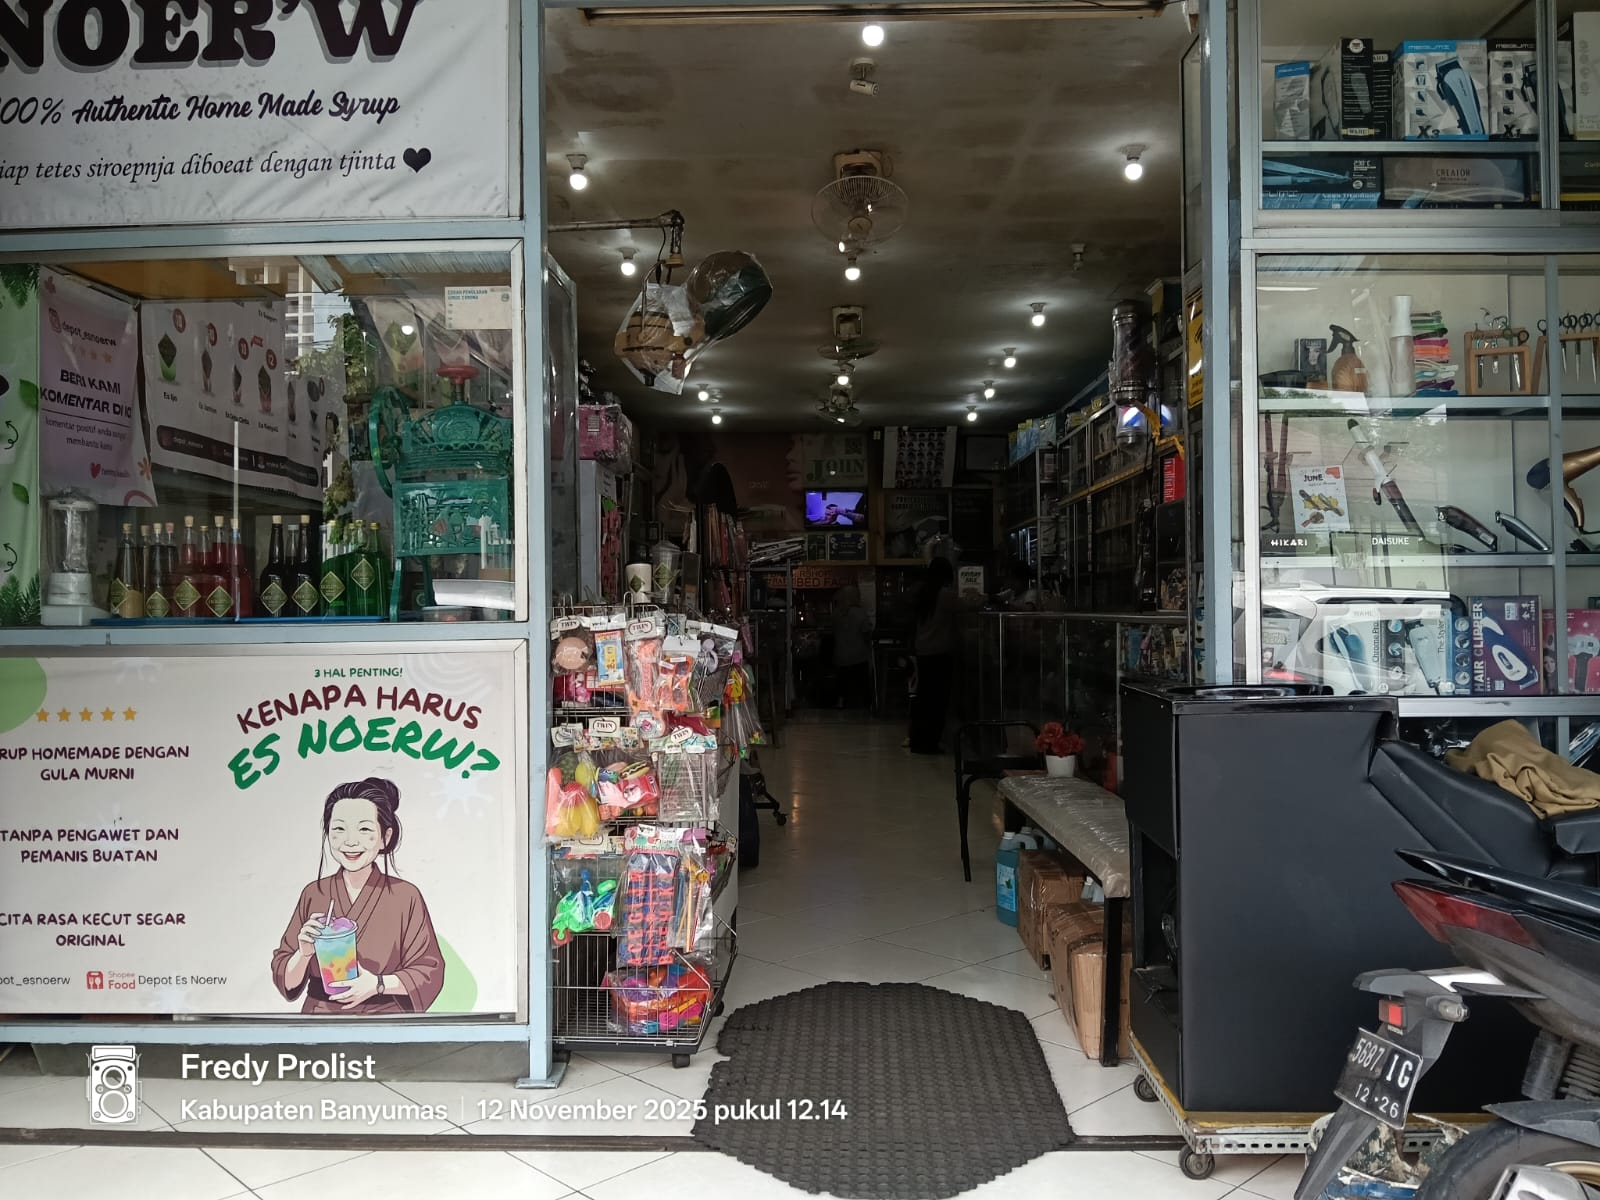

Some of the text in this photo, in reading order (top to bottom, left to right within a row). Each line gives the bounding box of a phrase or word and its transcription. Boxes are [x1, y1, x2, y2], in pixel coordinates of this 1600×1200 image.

[0, 89, 401, 126] 00% Authentic Home Made Syrup
[35, 161, 81, 179] tetes
[87, 154, 175, 184] siroepnja
[181, 152, 254, 176] diboeat
[260, 150, 333, 181] dengan
[339, 150, 397, 182] tjinta
[60, 369, 121, 395] BERI KAMI
[40, 387, 110, 415] KOMENTAR
[1303, 473, 1324, 482] JUNE
[1371, 537, 1410, 545] DAISUKE
[1472, 603, 1484, 692] HAIR CLIPPER
[314, 667, 403, 678] 3 HAL PENTING!
[236, 684, 482, 734] KENAPA HARUS
[32, 746, 120, 760] HOMEMADE
[125, 745, 189, 759] DENGAN
[227, 715, 501, 790] ES NOERW?
[40, 767, 135, 781] GULA MURNI
[0, 828, 179, 842] TANPA PENGAWET DAN
[21, 849, 158, 863] PEMANIS BUATAN
[0, 912, 186, 926] CITA RASA KECUT SEGAR
[56, 934, 126, 947] ORIGINAL
[108, 970, 136, 979] Shopee
[138, 975, 227, 988] Depot Es Noerw
[108, 979, 136, 990] Food
[1352, 1038, 1413, 1088] 5687 IG
